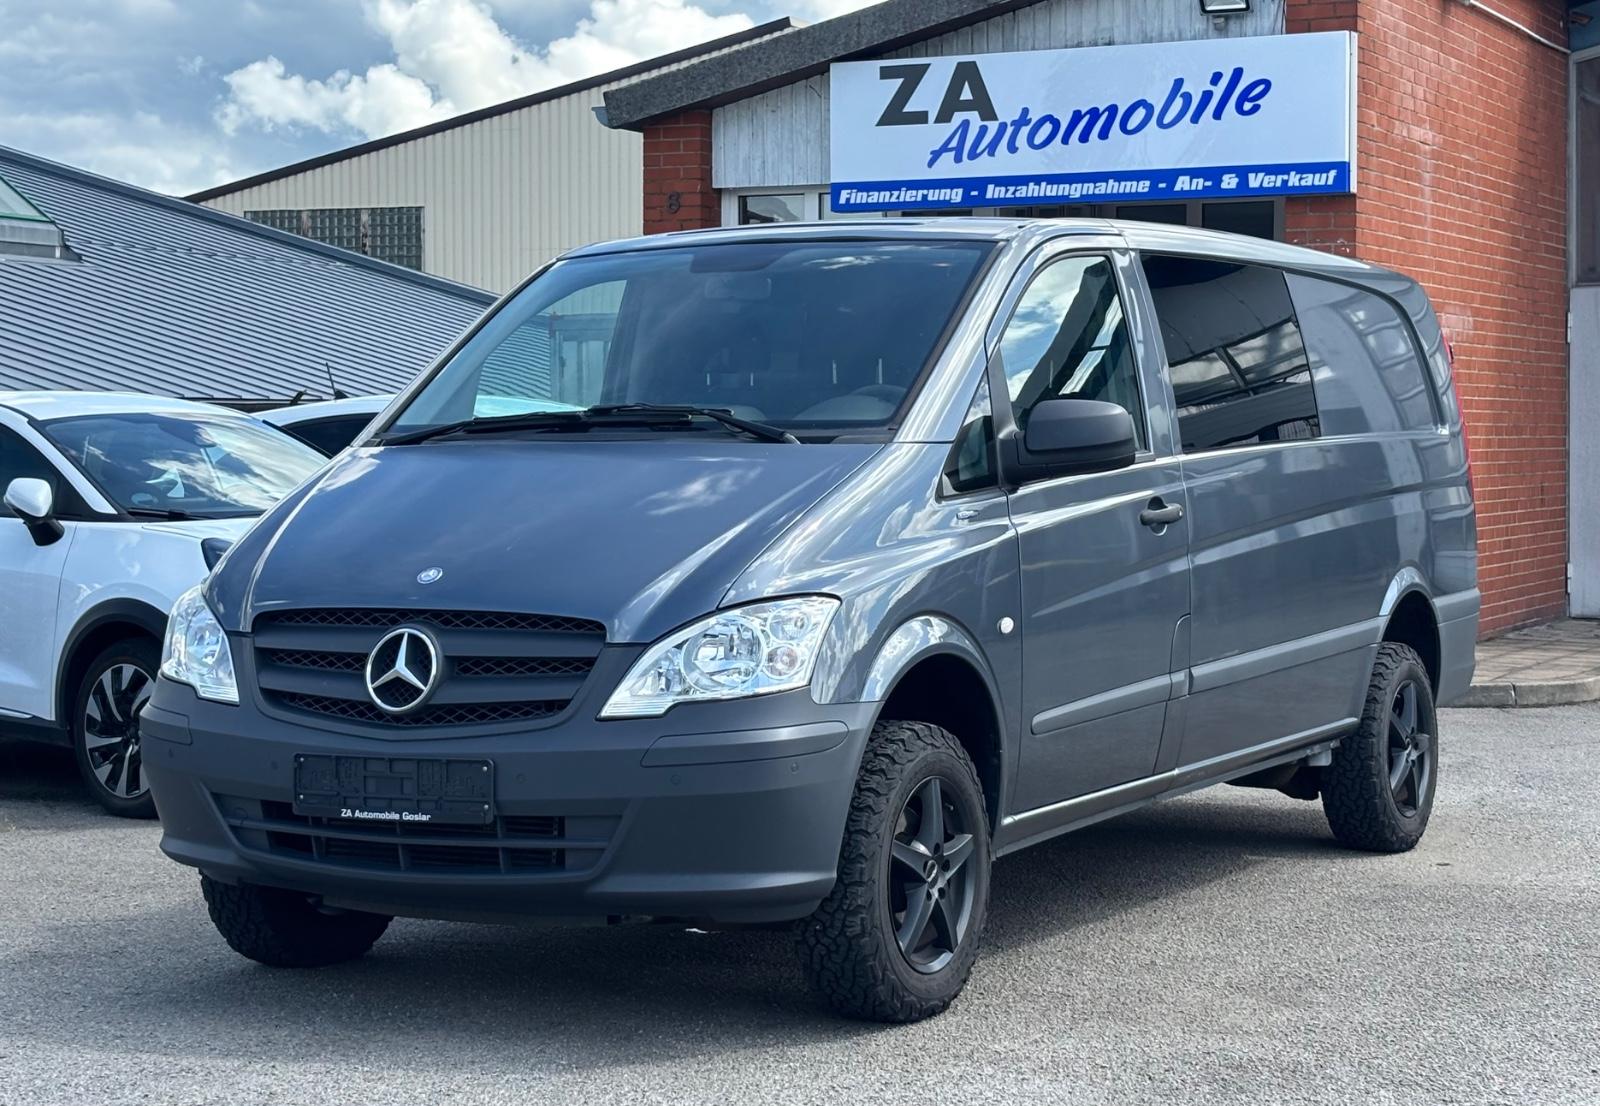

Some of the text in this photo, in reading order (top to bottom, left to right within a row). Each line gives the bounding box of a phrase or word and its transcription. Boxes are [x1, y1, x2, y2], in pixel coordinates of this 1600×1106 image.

[874, 61, 1000, 126] ZA
[927, 66, 1272, 168] Automobile
[839, 187, 963, 204] Finanzierung
[985, 179, 1150, 199] Inzahlungnahme
[1174, 175, 1212, 191] An-
[1220, 173, 1239, 190] &
[1248, 170, 1337, 188] Verkauf
[341, 808, 431, 821] ZA Automobile Goslar
